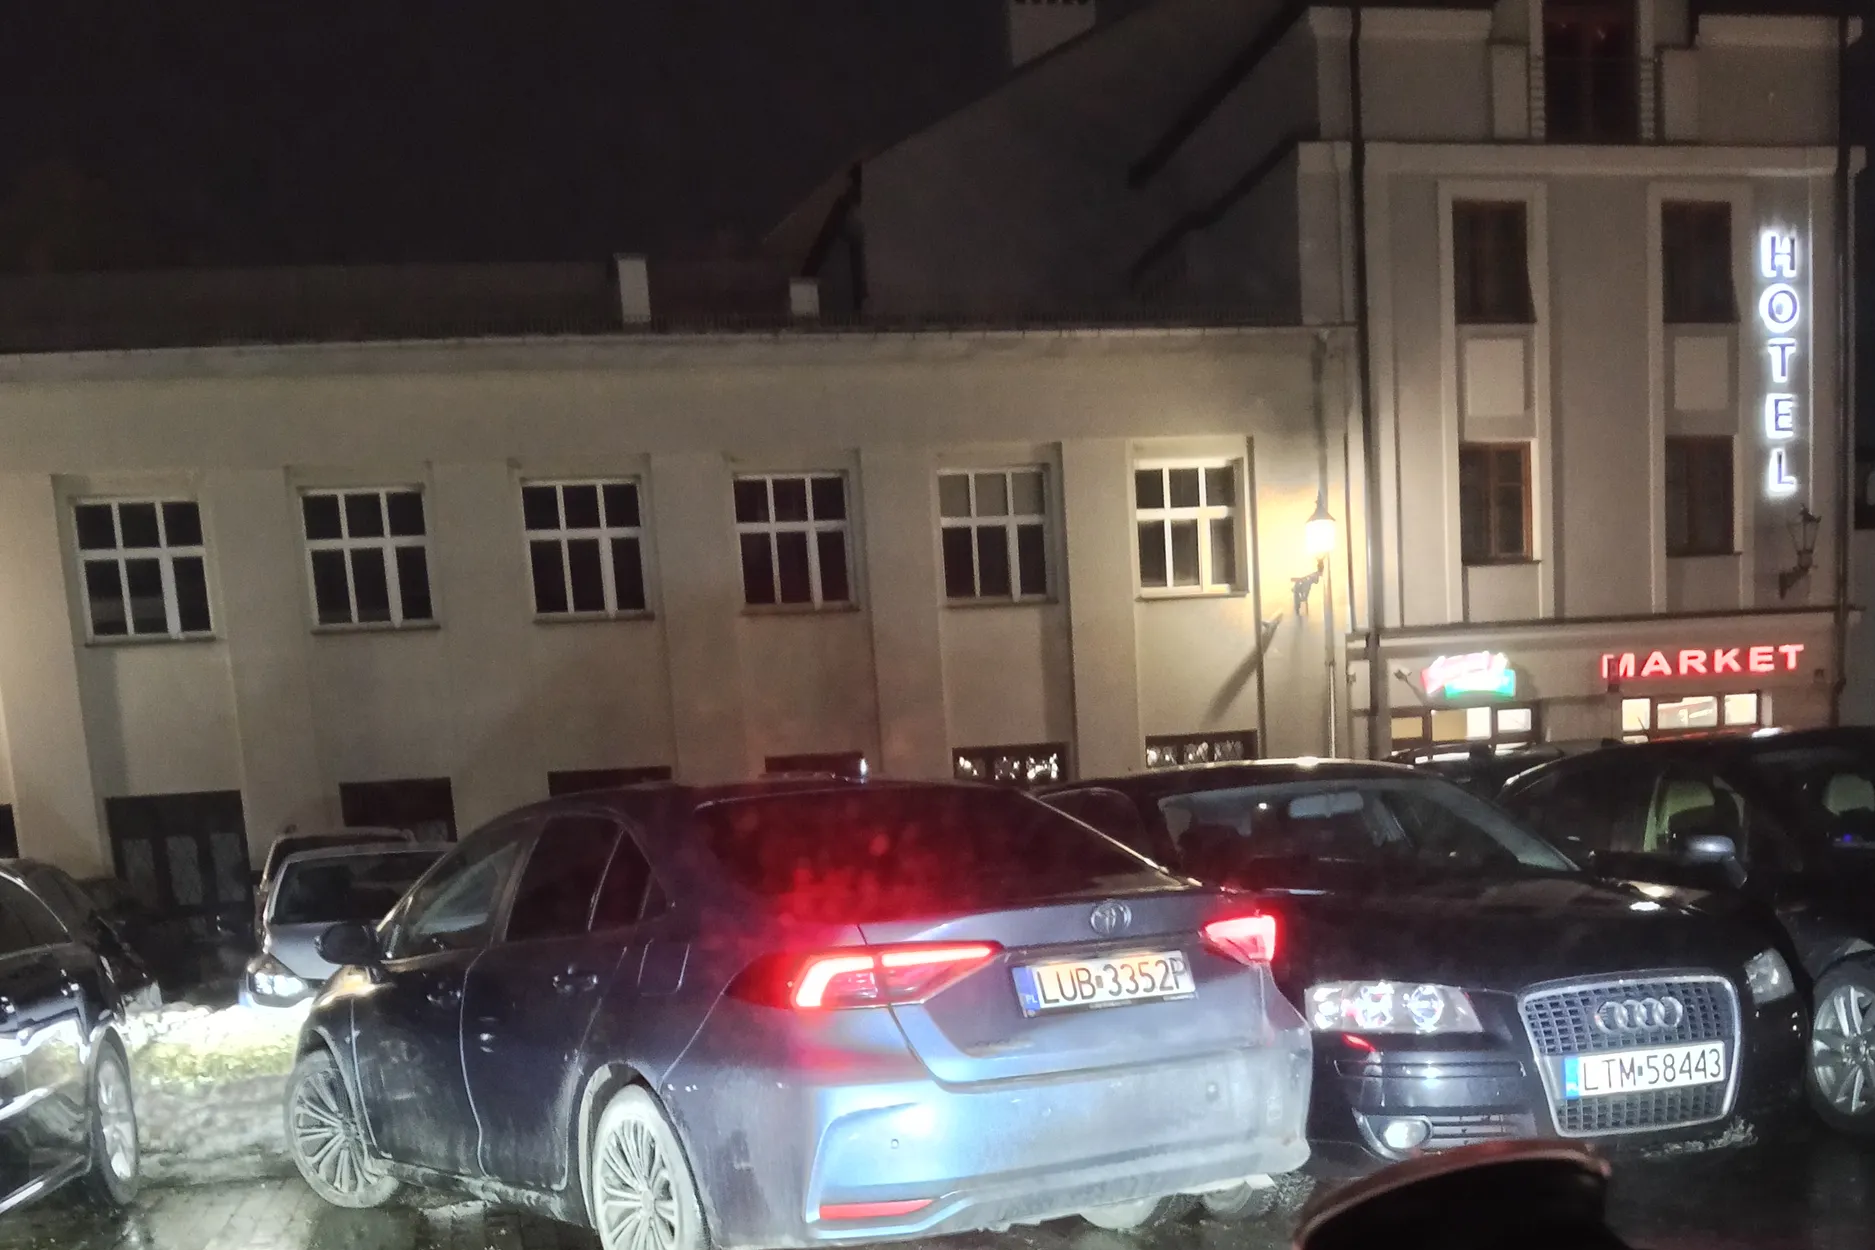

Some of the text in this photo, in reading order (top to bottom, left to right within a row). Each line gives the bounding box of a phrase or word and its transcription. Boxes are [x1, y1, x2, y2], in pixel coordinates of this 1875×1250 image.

[1760, 231, 1799, 491] HOTEL
[1602, 644, 1805, 679] MARKET
[1037, 957, 1186, 1004] LUB 3352P
[1584, 1048, 1721, 1091] LTM 58443
